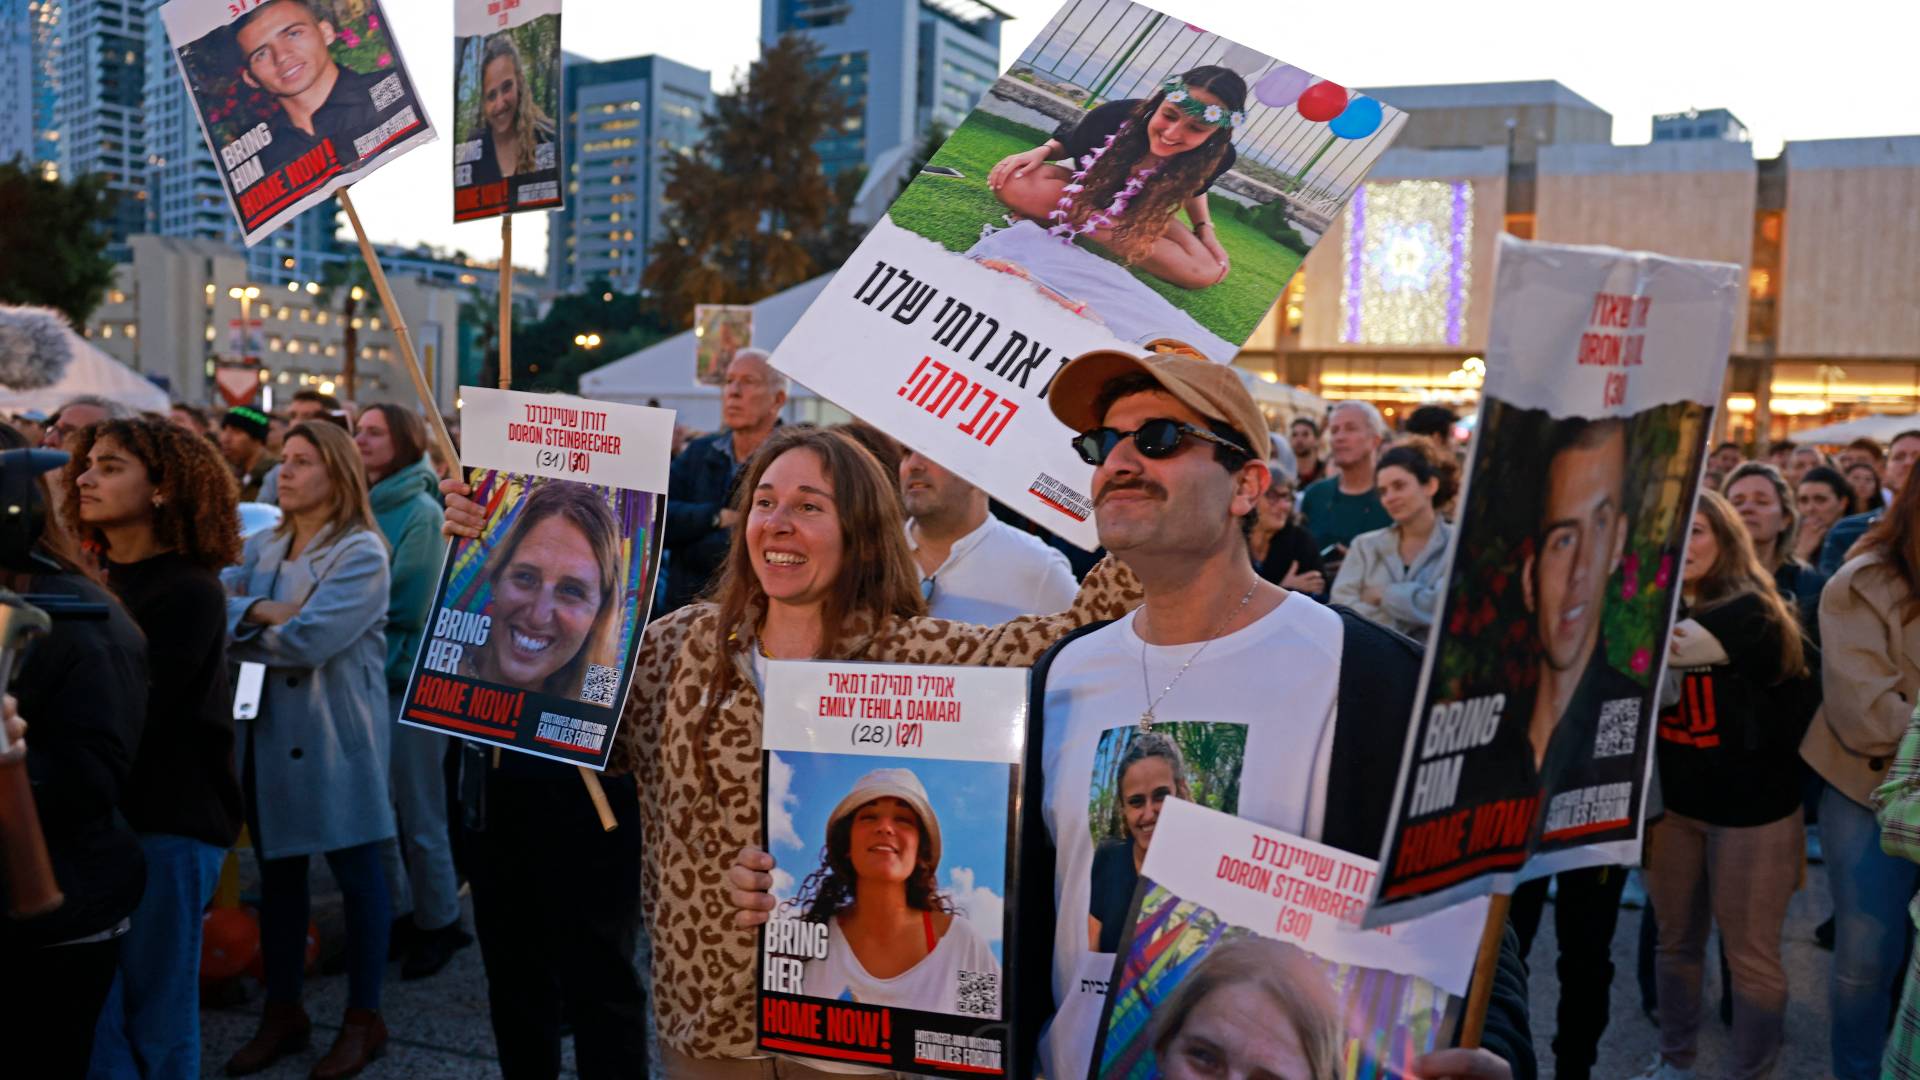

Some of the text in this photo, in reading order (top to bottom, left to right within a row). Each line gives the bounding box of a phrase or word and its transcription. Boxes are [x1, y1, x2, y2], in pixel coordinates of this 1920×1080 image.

[221, 122, 273, 171] BRING
[230, 155, 265, 193] HIM
[239, 138, 338, 218] HOME NOW!
[852, 260, 939, 325] שלנו
[931, 296, 999, 362] רומי
[985, 330, 1052, 389] את
[896, 355, 1020, 447] הביתה!
[508, 423, 621, 455] DORON STEINBRECHER
[581, 412, 607, 432] דורון
[536, 450, 566, 471] (31)
[433, 607, 491, 646] BRING
[424, 639, 464, 675] HER
[414, 675, 526, 727] HOME NOW!
[828, 671, 955, 698] אמילי תהילה דמארי
[819, 696, 961, 722] EMILY TEHILA DAMARI
[1421, 693, 1506, 760] BRING
[536, 721, 605, 750] FAMILIES FORUM
[851, 723, 892, 748] (28)
[1408, 753, 1464, 819] HIM
[1394, 809, 1471, 878] HOME
[1216, 855, 1270, 893] DORON
[765, 919, 829, 959] BRING
[1276, 908, 1312, 942] (30)
[763, 953, 804, 995] HER
[764, 997, 891, 1050] HOME NOW!
[915, 1041, 1002, 1069] FAMILIES FORUM
